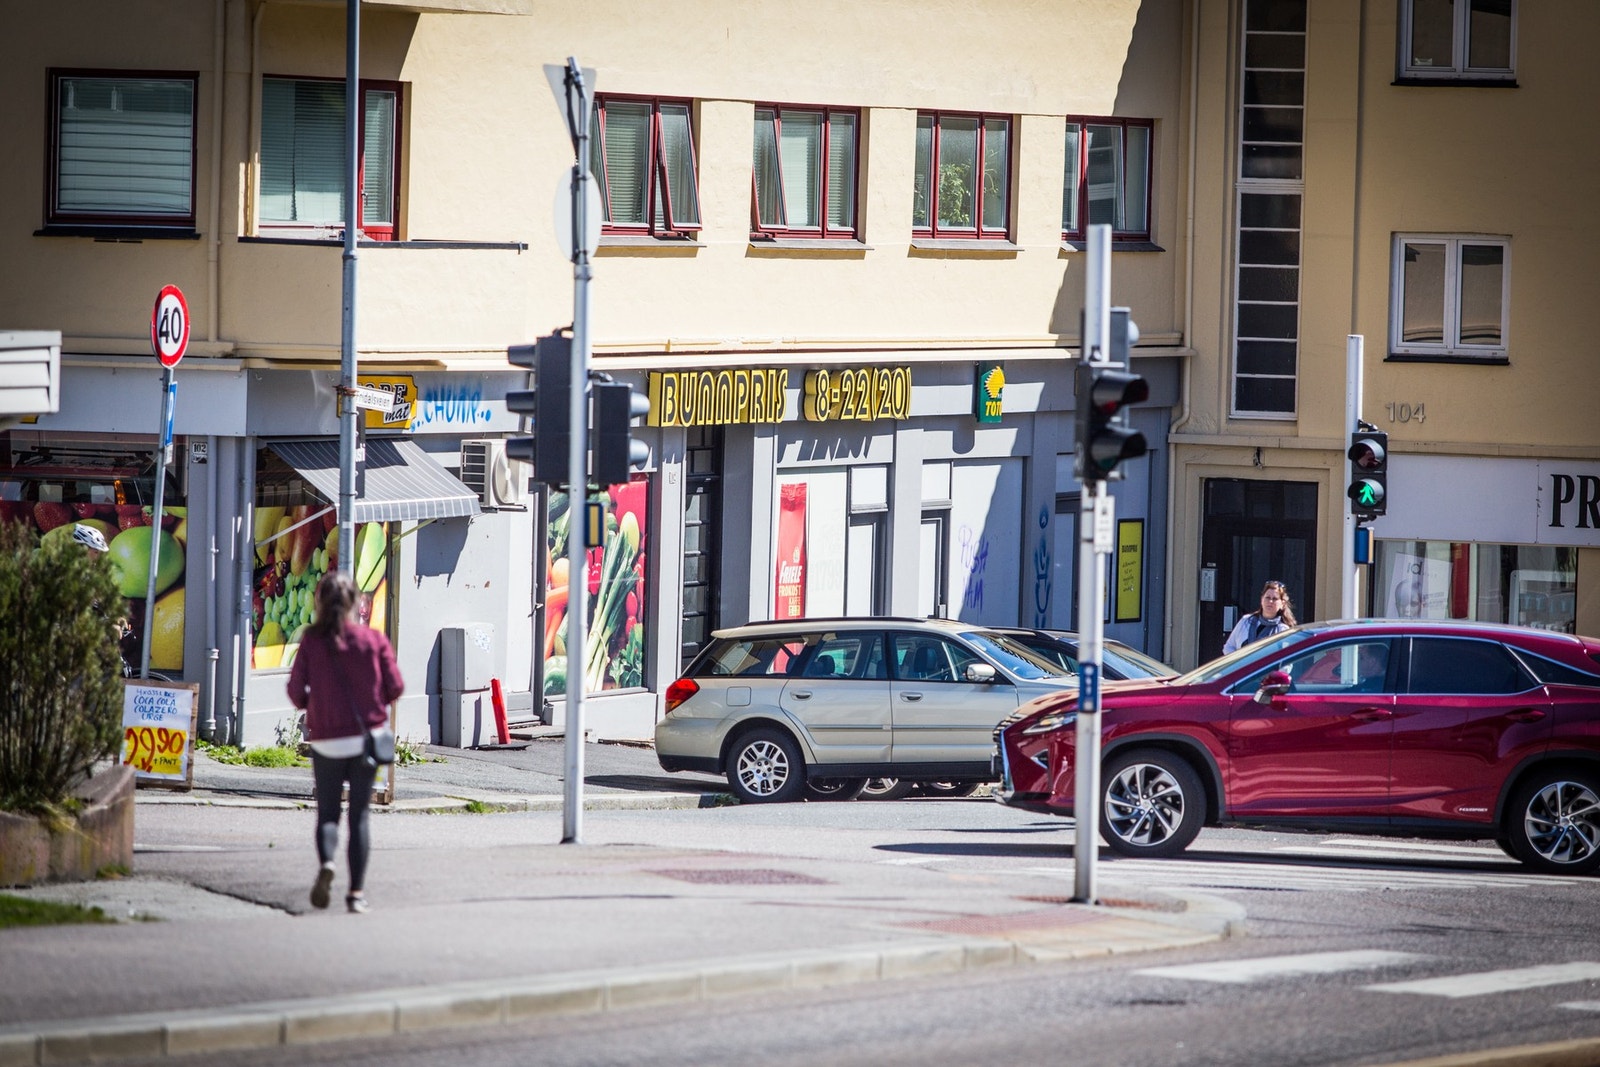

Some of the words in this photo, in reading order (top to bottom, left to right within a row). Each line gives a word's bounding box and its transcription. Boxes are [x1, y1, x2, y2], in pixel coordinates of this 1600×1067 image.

[159, 307, 182, 344] 40
[658, 368, 788, 427] BUNNPRIS
[1385, 402, 1426, 423] 104
[193, 442, 207, 452] 102
[1548, 474, 1600, 529] PR
[779, 560, 802, 584] FRIELE
[778, 584, 801, 597] FROKOST
[134, 696, 154, 705] COCA
[156, 697, 176, 706] COLA
[141, 713, 163, 721] URGE
[159, 757, 178, 766] PANT
